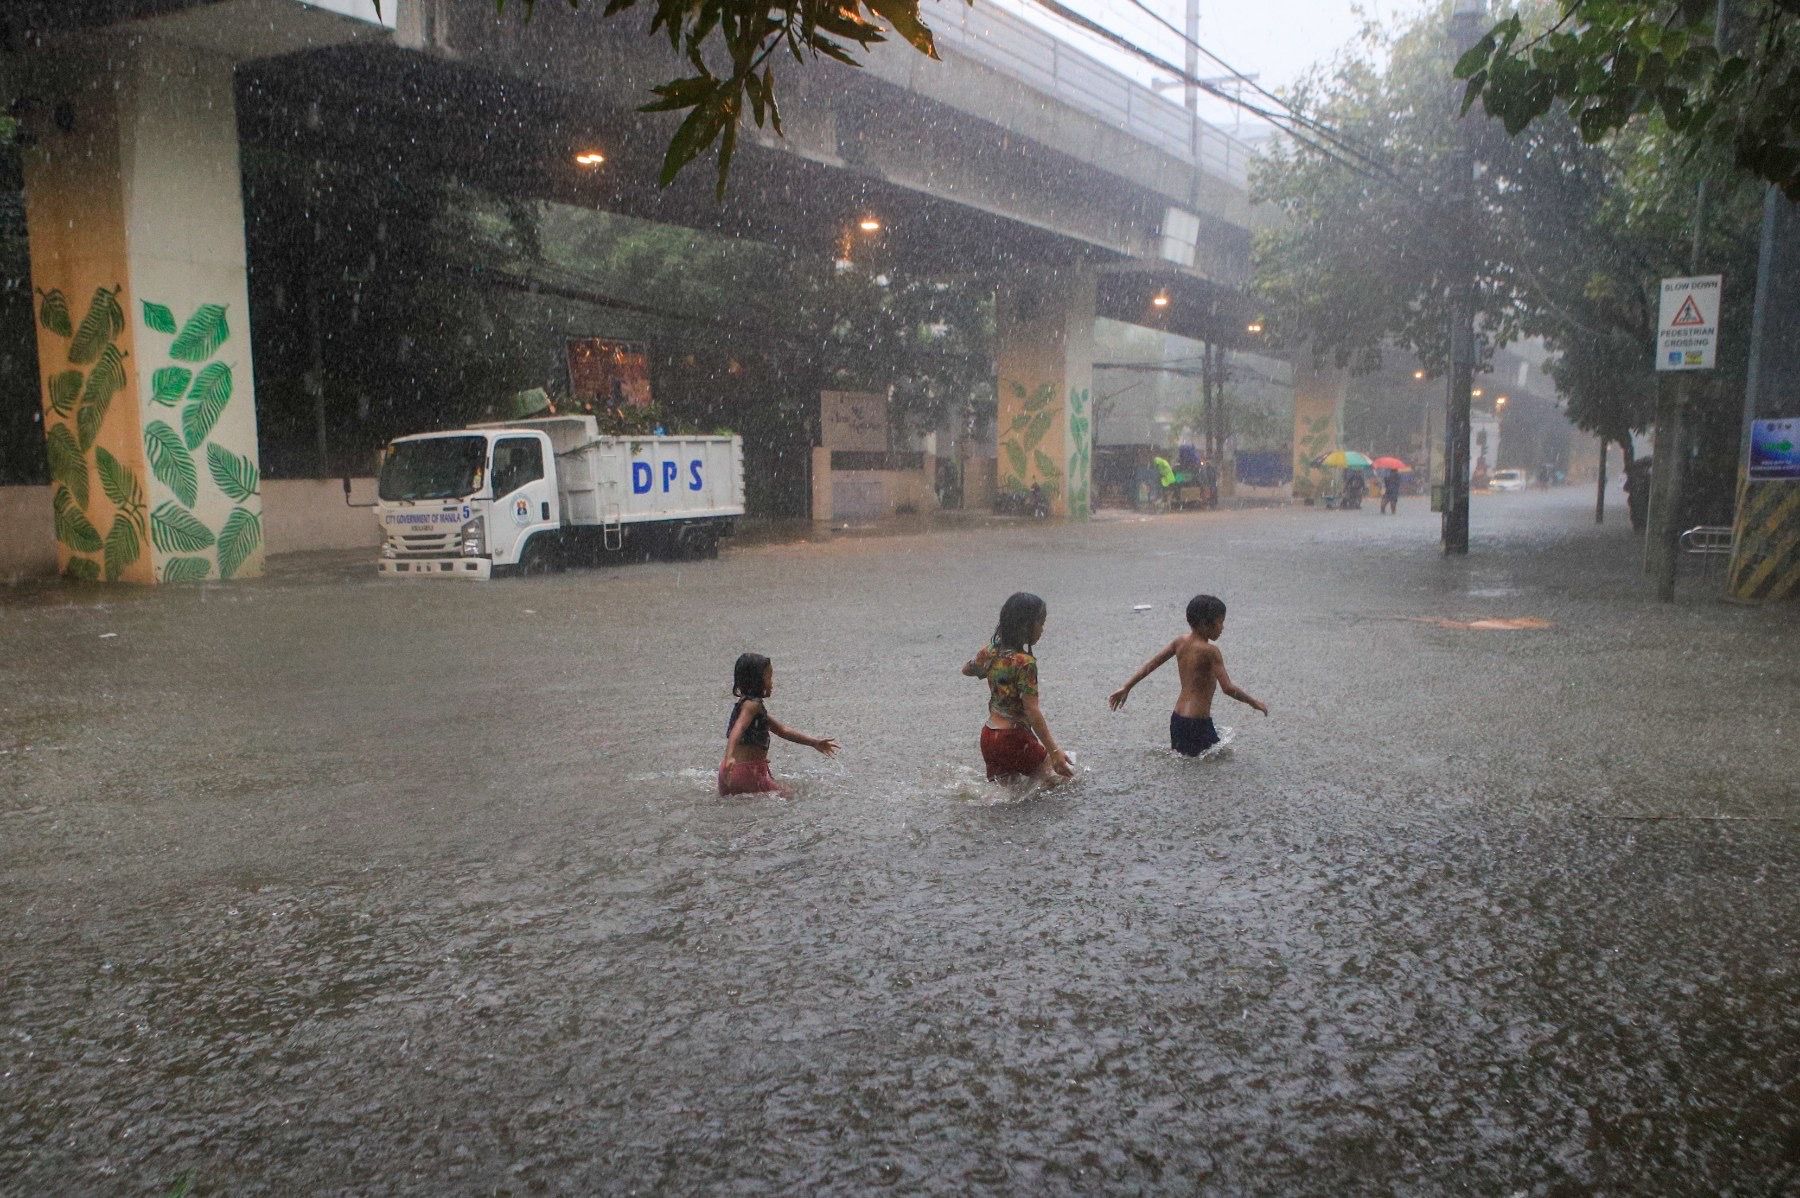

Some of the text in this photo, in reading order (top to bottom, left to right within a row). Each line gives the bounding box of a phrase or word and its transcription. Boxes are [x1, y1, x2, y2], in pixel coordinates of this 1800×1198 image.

[1665, 281, 1718, 292] SLOW DOWN
[1660, 328, 1714, 337] PEDESTRIAN
[1665, 338, 1708, 347] CROSSING
[463, 505, 470, 519] 5
[385, 512, 461, 524] CITY GOVERNMENT OF MANILA
